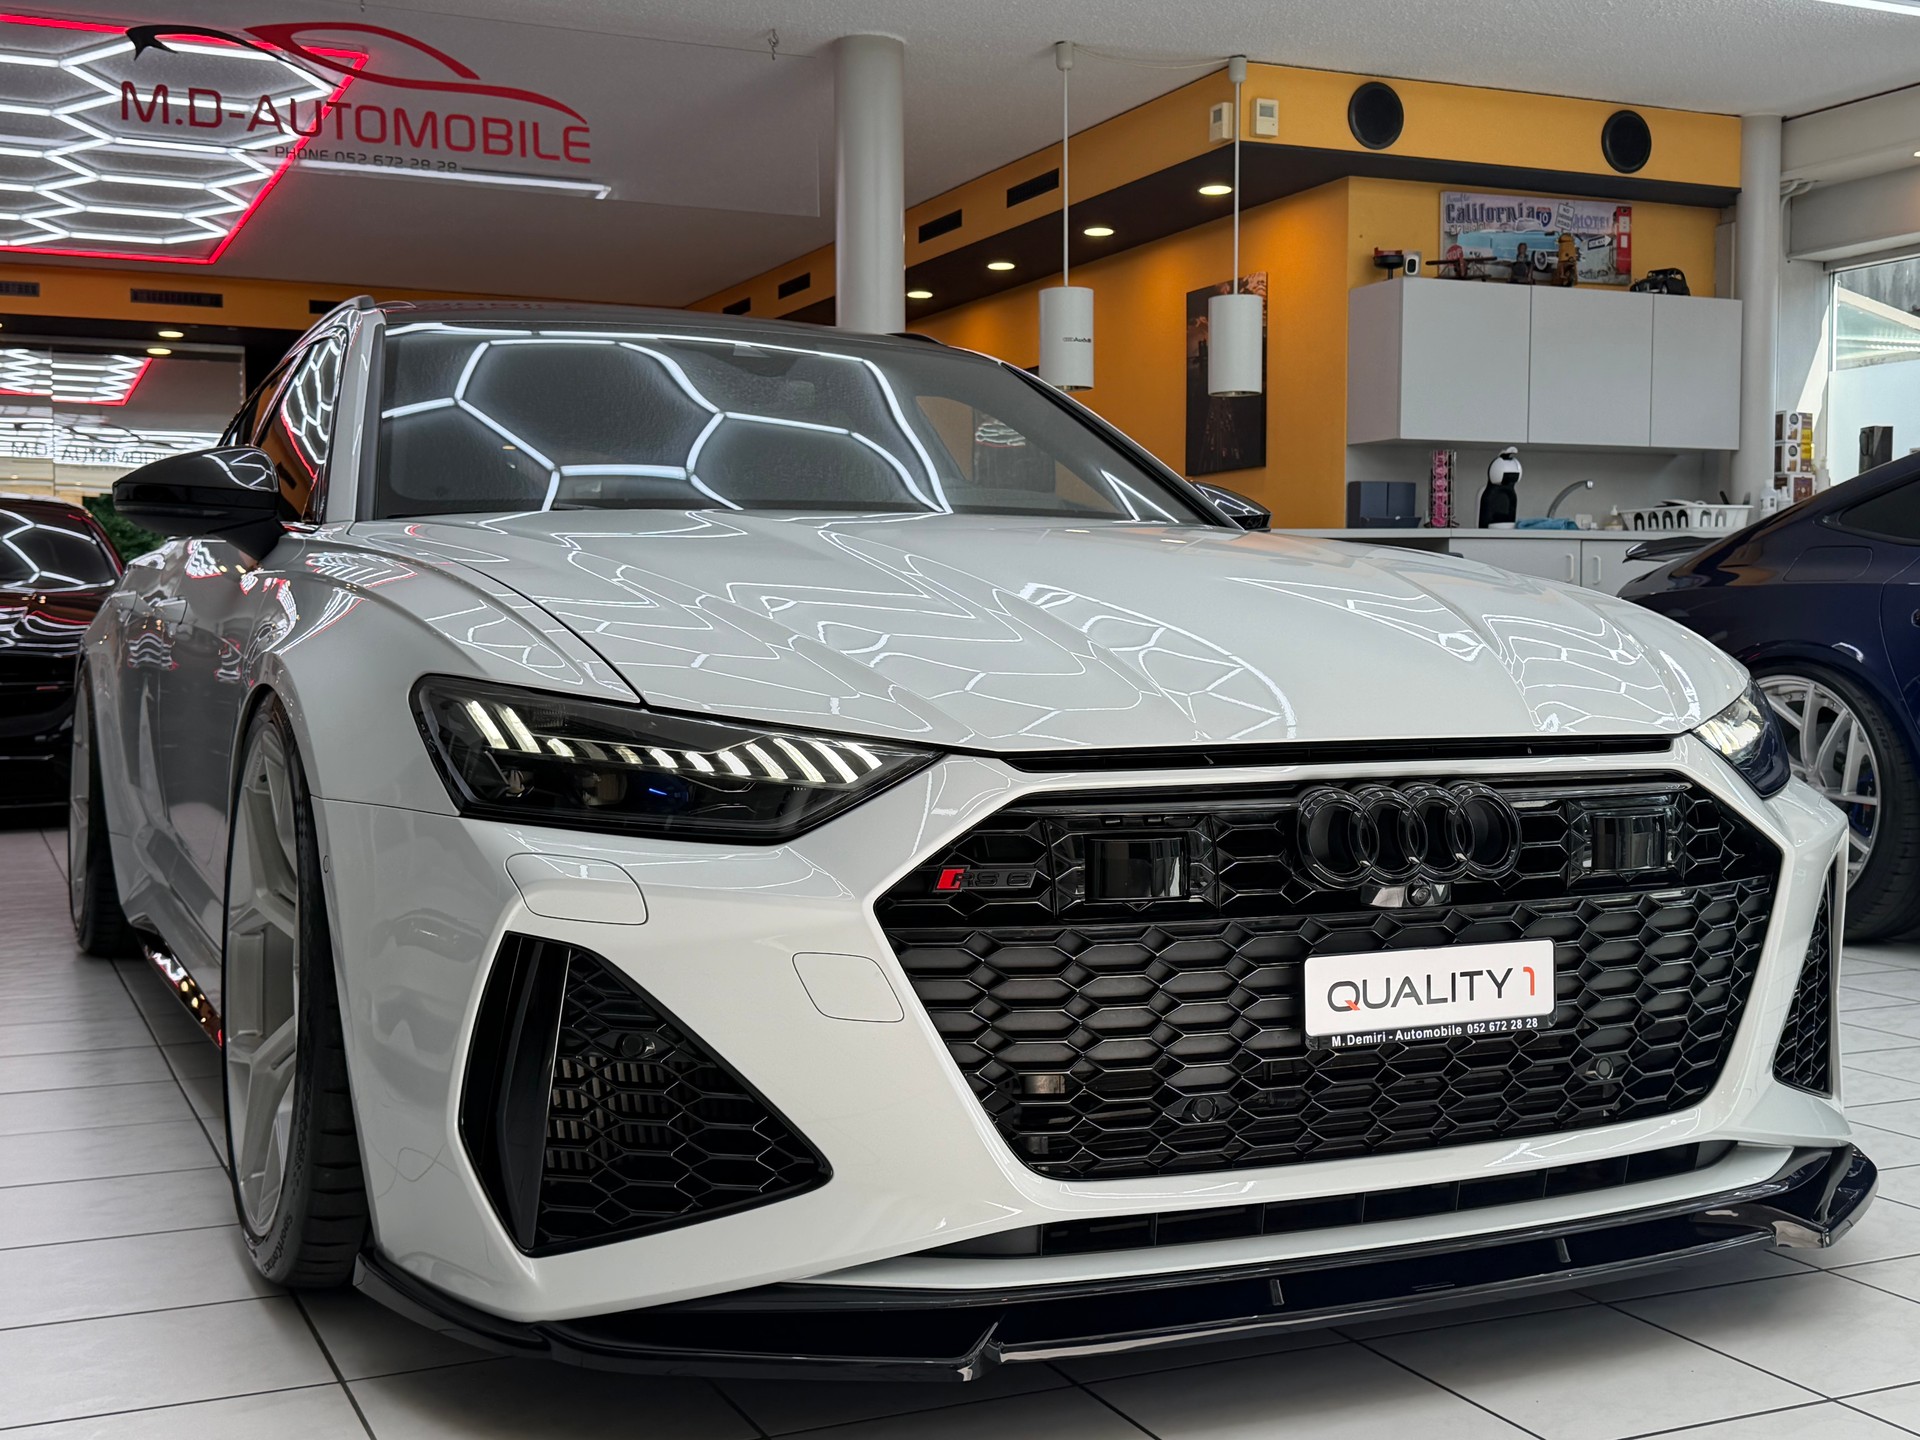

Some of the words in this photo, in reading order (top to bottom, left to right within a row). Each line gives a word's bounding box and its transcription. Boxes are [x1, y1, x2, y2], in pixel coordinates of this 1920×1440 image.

[121, 81, 591, 163] M.D-AUTOMOBILE
[275, 145, 329, 161] PHONE
[335, 151, 367, 165] 052
[373, 154, 404, 168] 672
[410, 158, 431, 171] 28
[437, 160, 458, 173] 28
[1446, 202, 1536, 224] California
[1539, 212, 1549, 224] 10
[1327, 967, 1514, 1012] QUALITY
[1522, 966, 1536, 997] 1
[1395, 1025, 1462, 1041] Automobile
[1467, 1022, 1486, 1034] 052
[1489, 1020, 1508, 1032] 672
[1511, 1018, 1523, 1030] 28
[1526, 1017, 1538, 1028] 28
